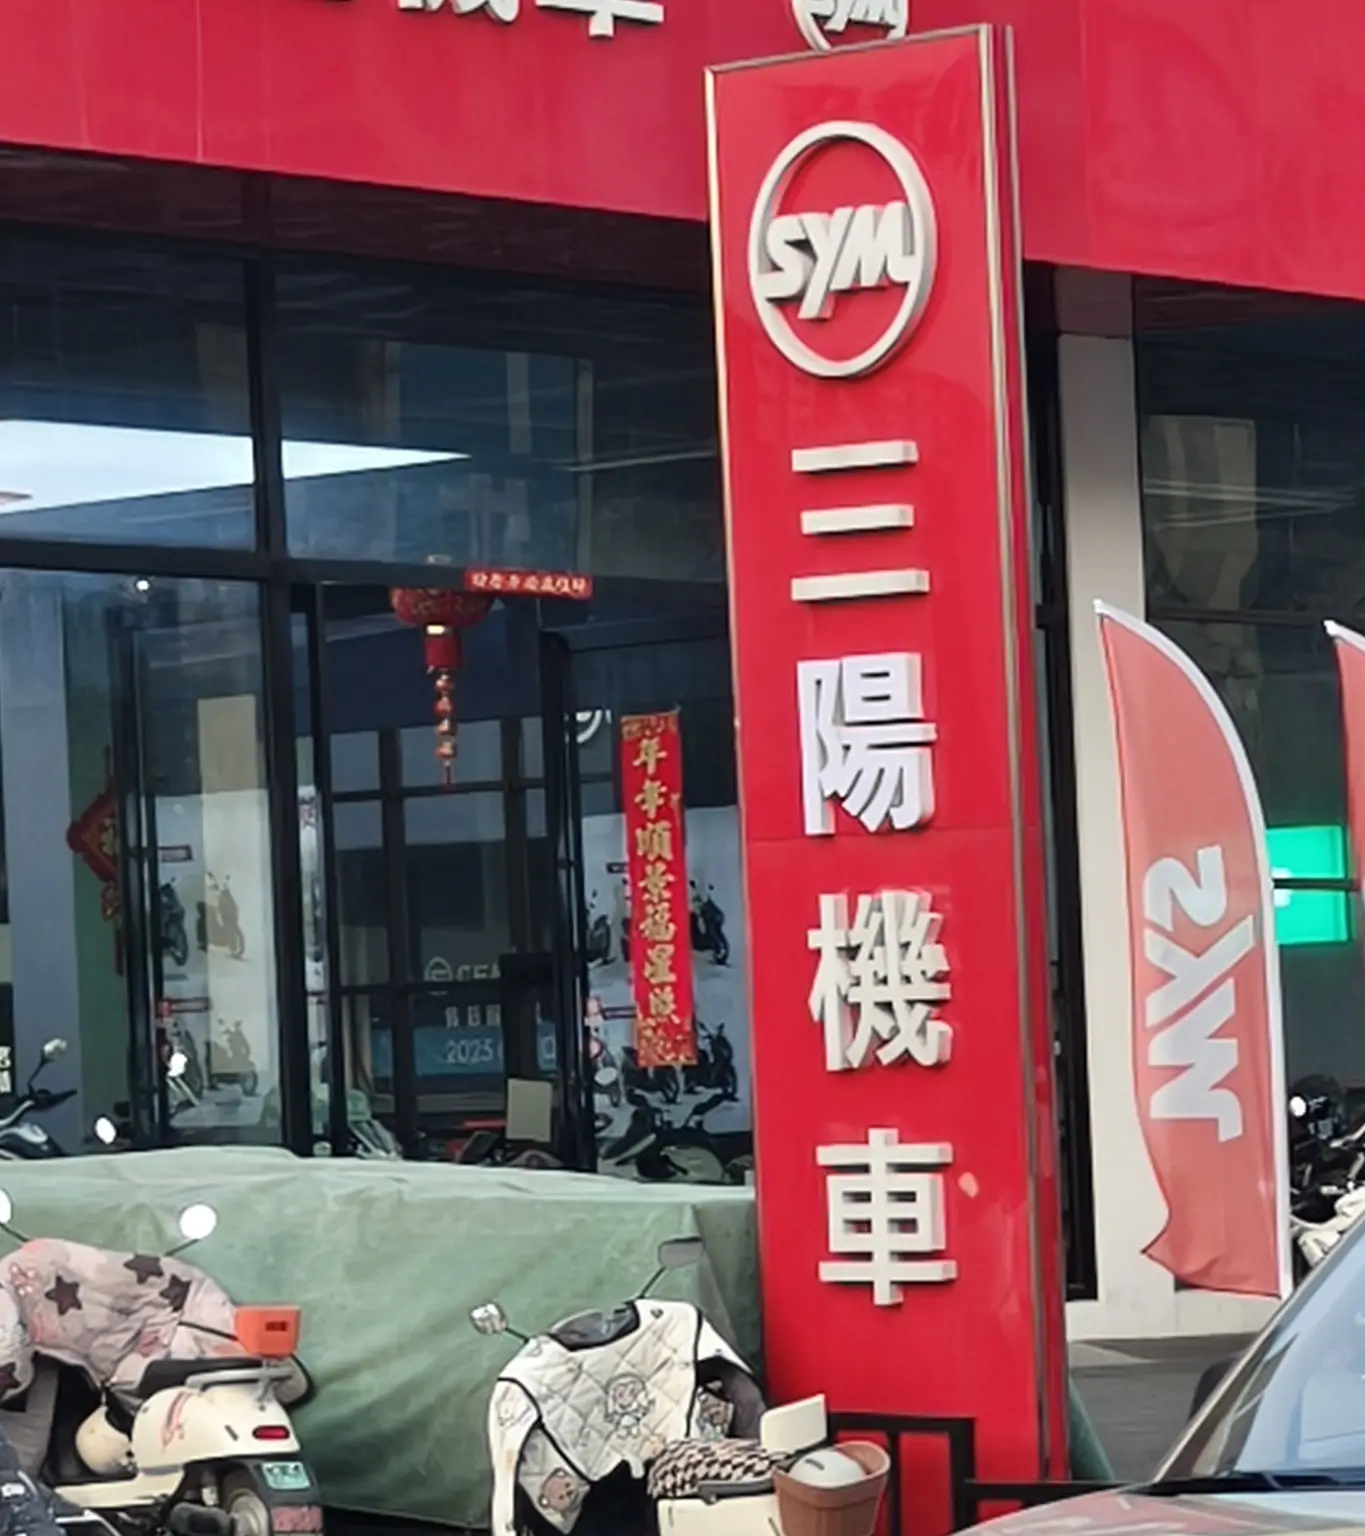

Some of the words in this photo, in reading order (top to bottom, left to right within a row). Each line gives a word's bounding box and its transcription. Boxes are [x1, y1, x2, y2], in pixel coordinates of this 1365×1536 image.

[757, 201, 918, 320] SYM
[790, 440, 957, 1306] 三陽機車
